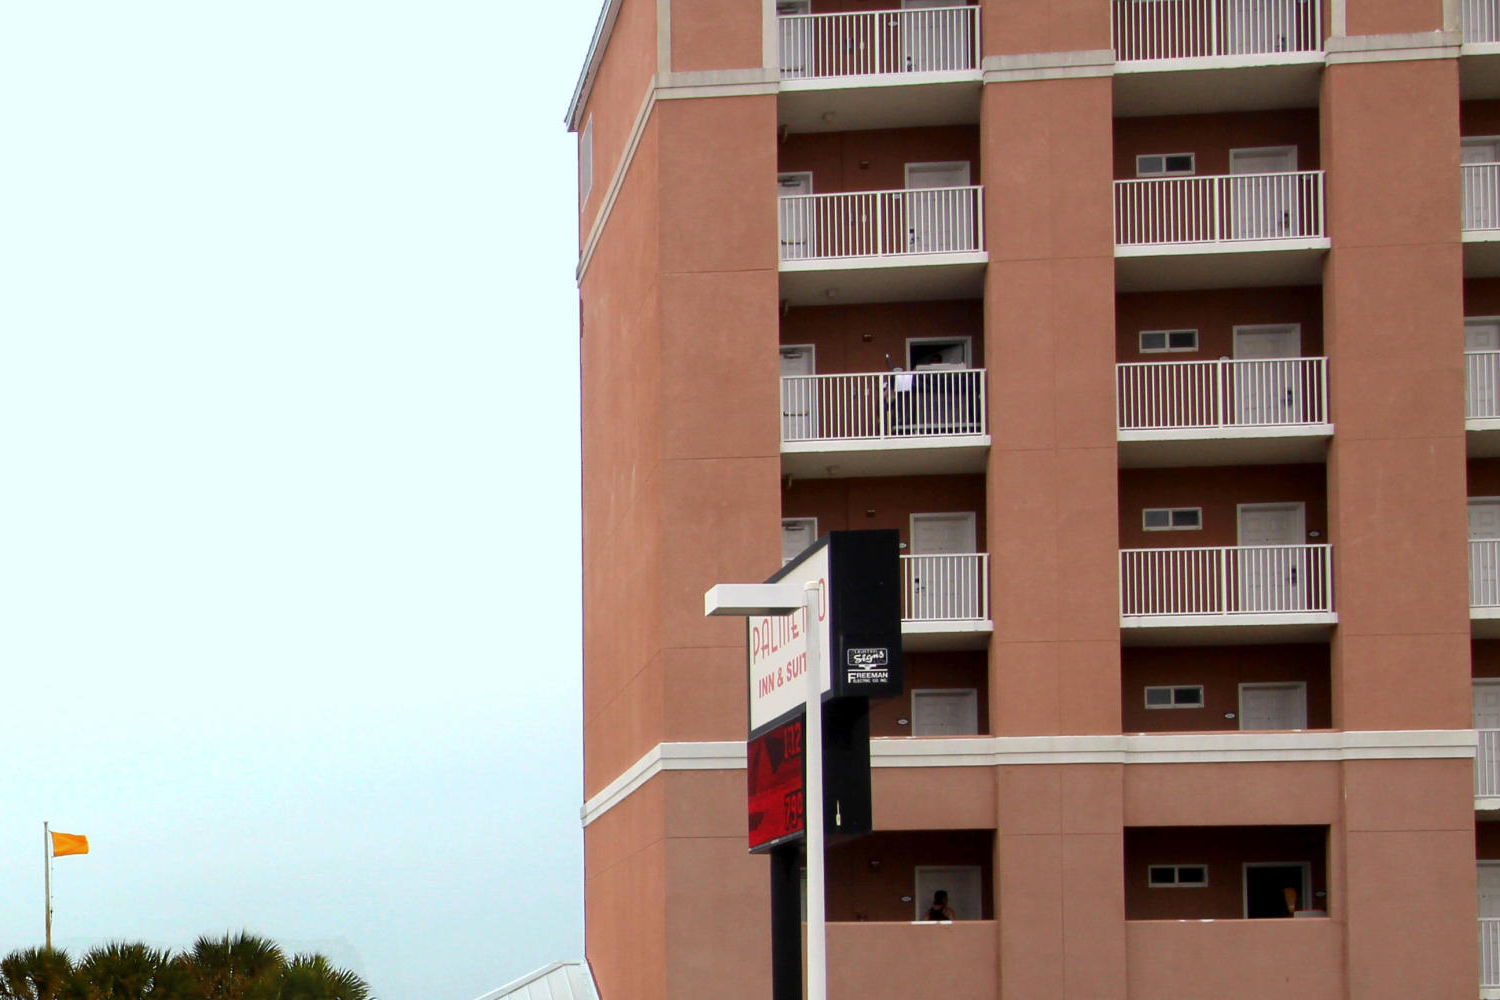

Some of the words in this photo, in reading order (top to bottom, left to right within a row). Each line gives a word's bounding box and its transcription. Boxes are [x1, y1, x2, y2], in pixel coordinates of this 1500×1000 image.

[752, 577, 826, 665] PALMETO
[853, 651, 885, 664] Signs
[758, 673, 775, 699] INN
[776, 666, 784, 688] &
[786, 652, 808, 683] SUIT
[847, 672, 888, 683] FREEMAN
